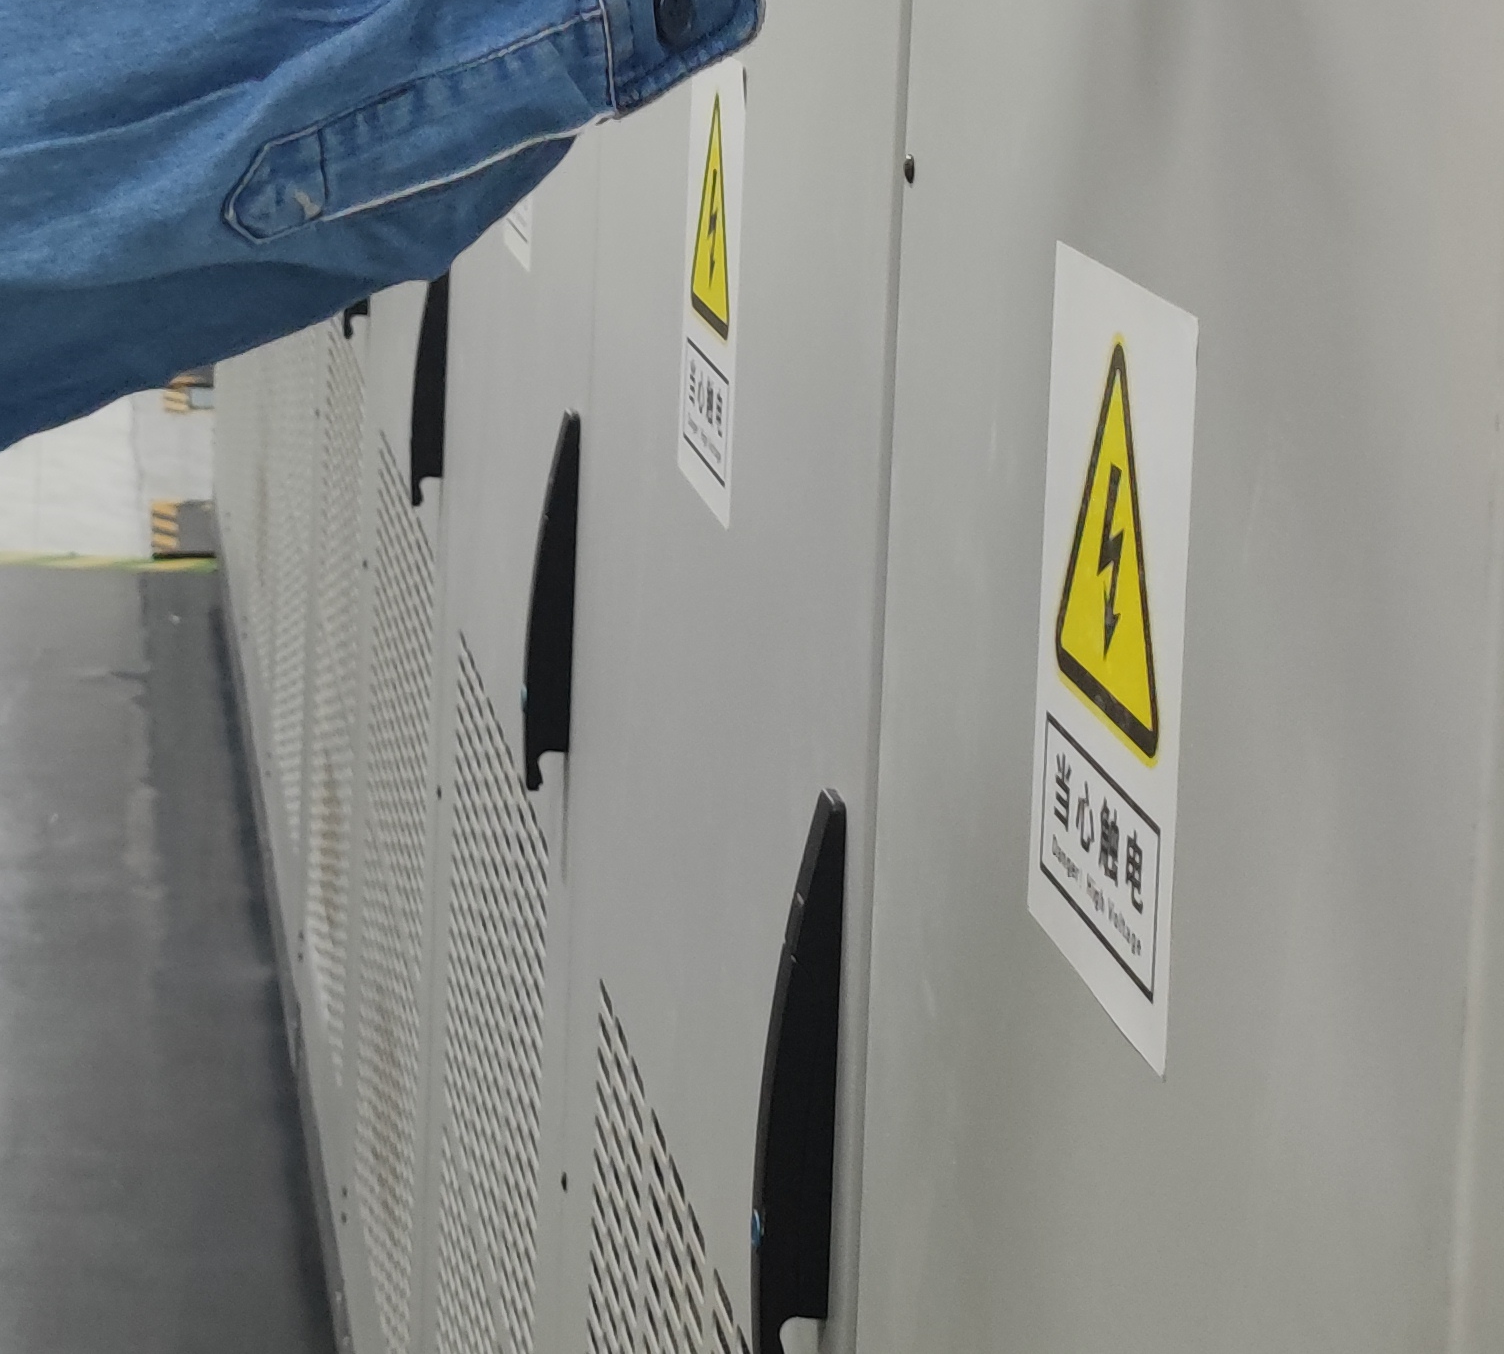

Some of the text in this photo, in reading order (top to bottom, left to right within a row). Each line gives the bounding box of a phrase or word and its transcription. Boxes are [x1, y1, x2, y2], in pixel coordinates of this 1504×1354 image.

[1054, 752, 1143, 914] 当心触电
[1108, 897, 1141, 956] Voltage
